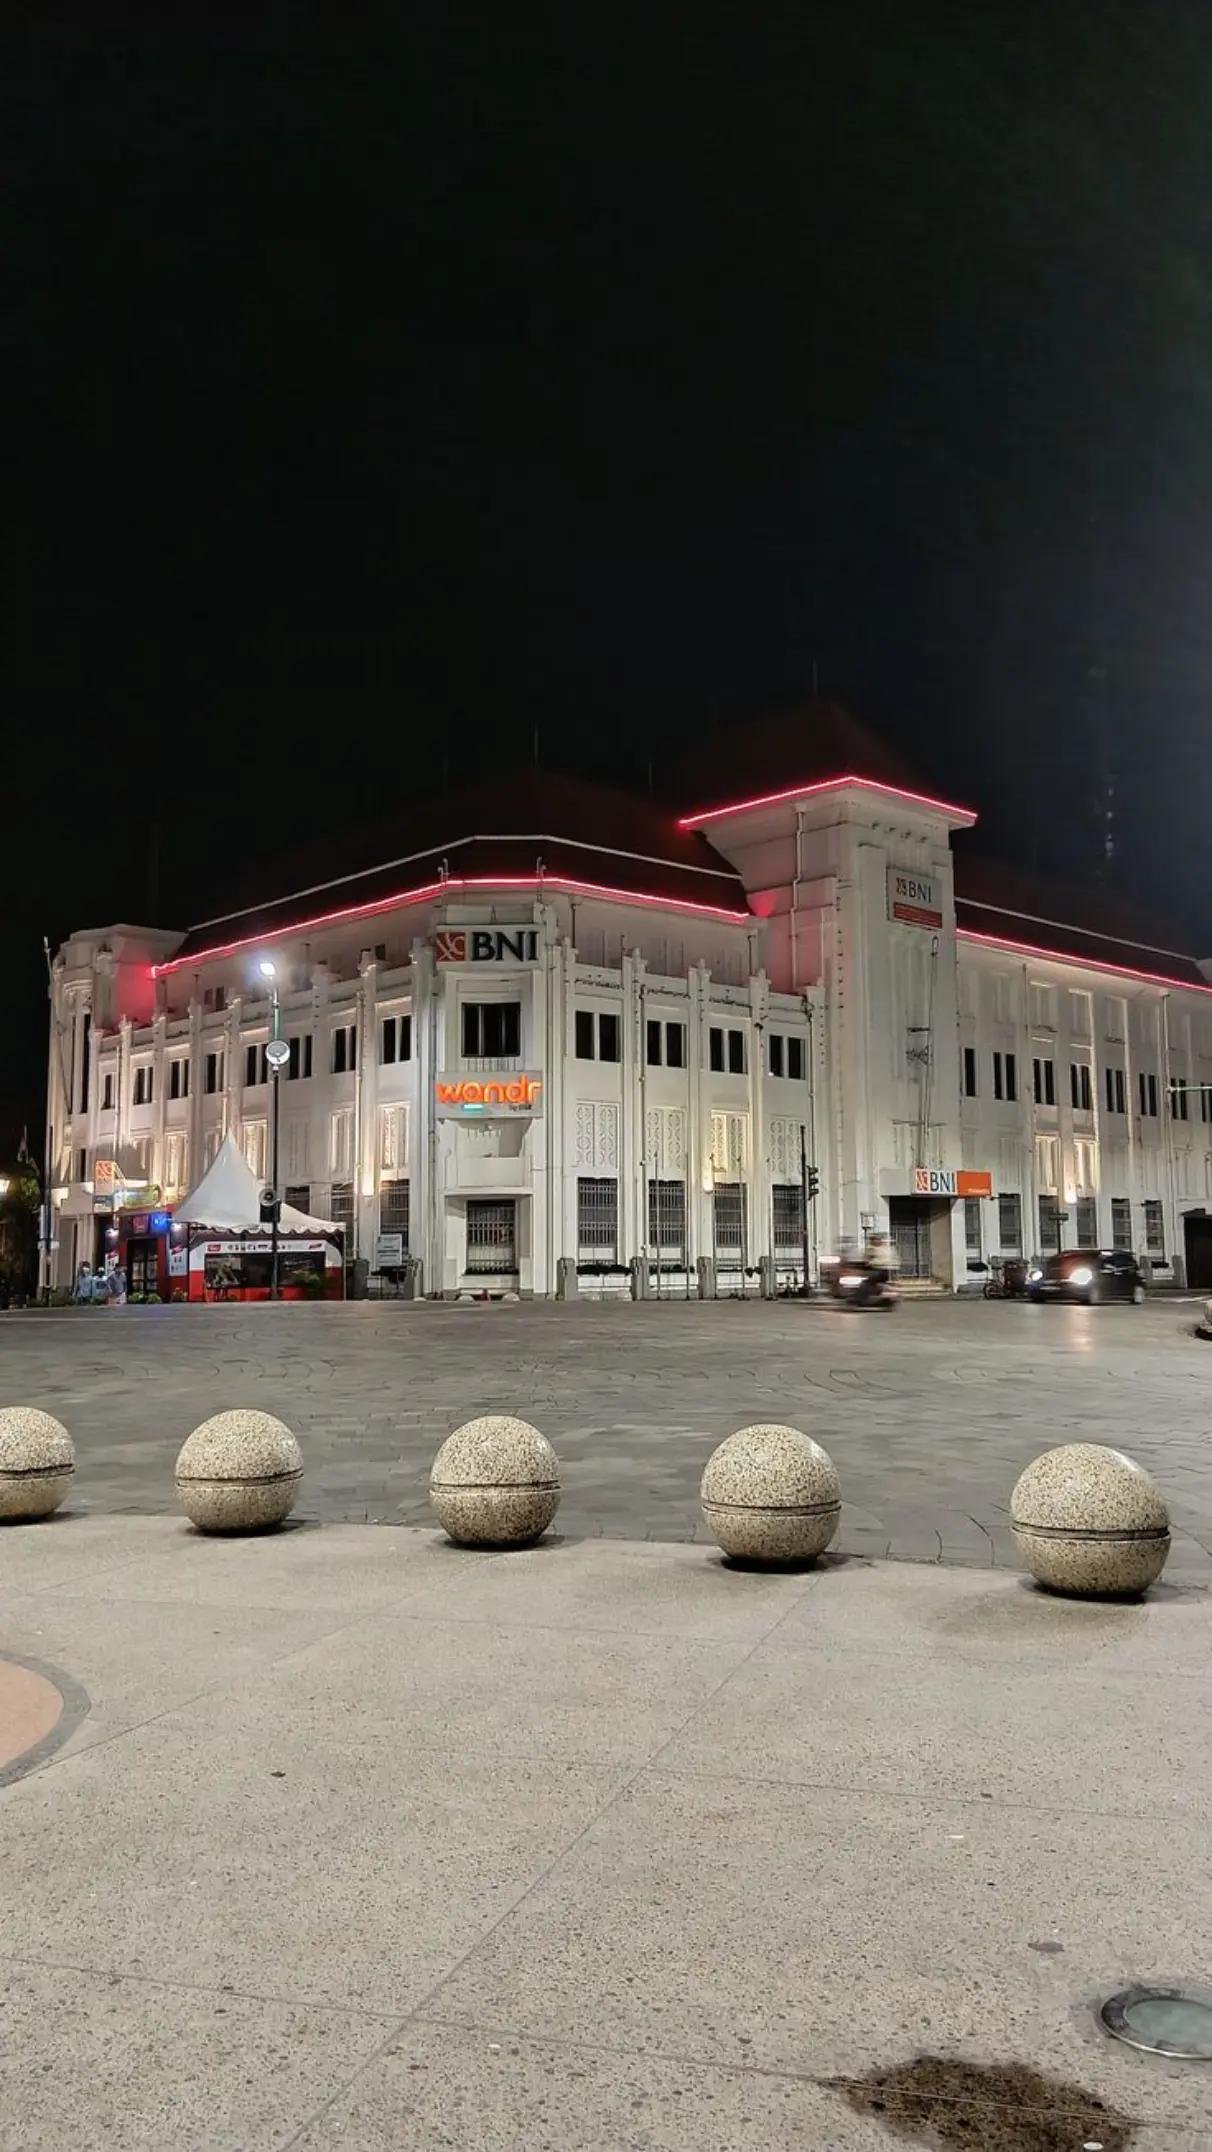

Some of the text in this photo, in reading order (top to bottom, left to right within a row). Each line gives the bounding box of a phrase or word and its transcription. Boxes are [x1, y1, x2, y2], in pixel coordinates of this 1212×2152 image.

[908, 880, 932, 904] BNI
[471, 931, 539, 962] BNI
[435, 1074, 542, 1104] wandr
[930, 1171, 956, 1193] BNI
